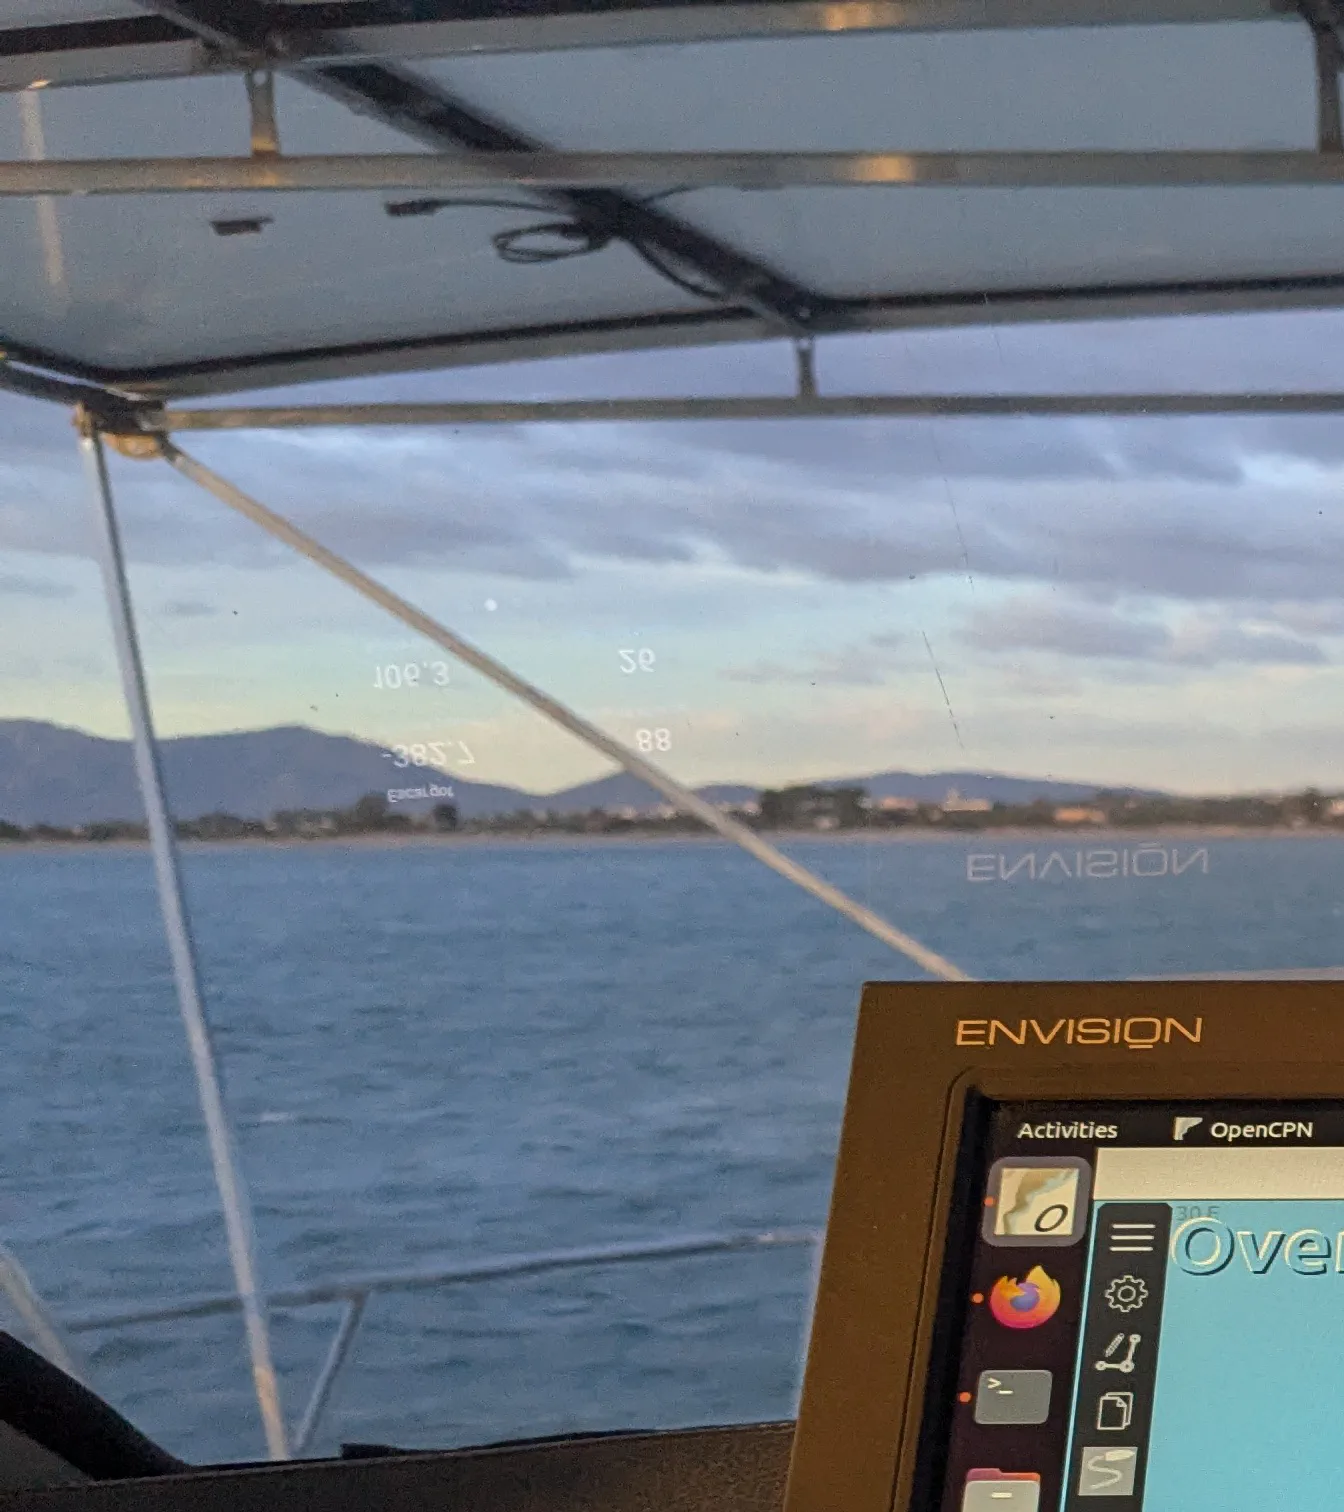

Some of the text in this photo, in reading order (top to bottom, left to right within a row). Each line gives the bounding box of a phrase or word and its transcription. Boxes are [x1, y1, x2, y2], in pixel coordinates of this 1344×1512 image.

[955, 1016, 1203, 1049] ENVISION
[1017, 1119, 1118, 1141] Activities
[1210, 1119, 1314, 1143] OpenCPN
